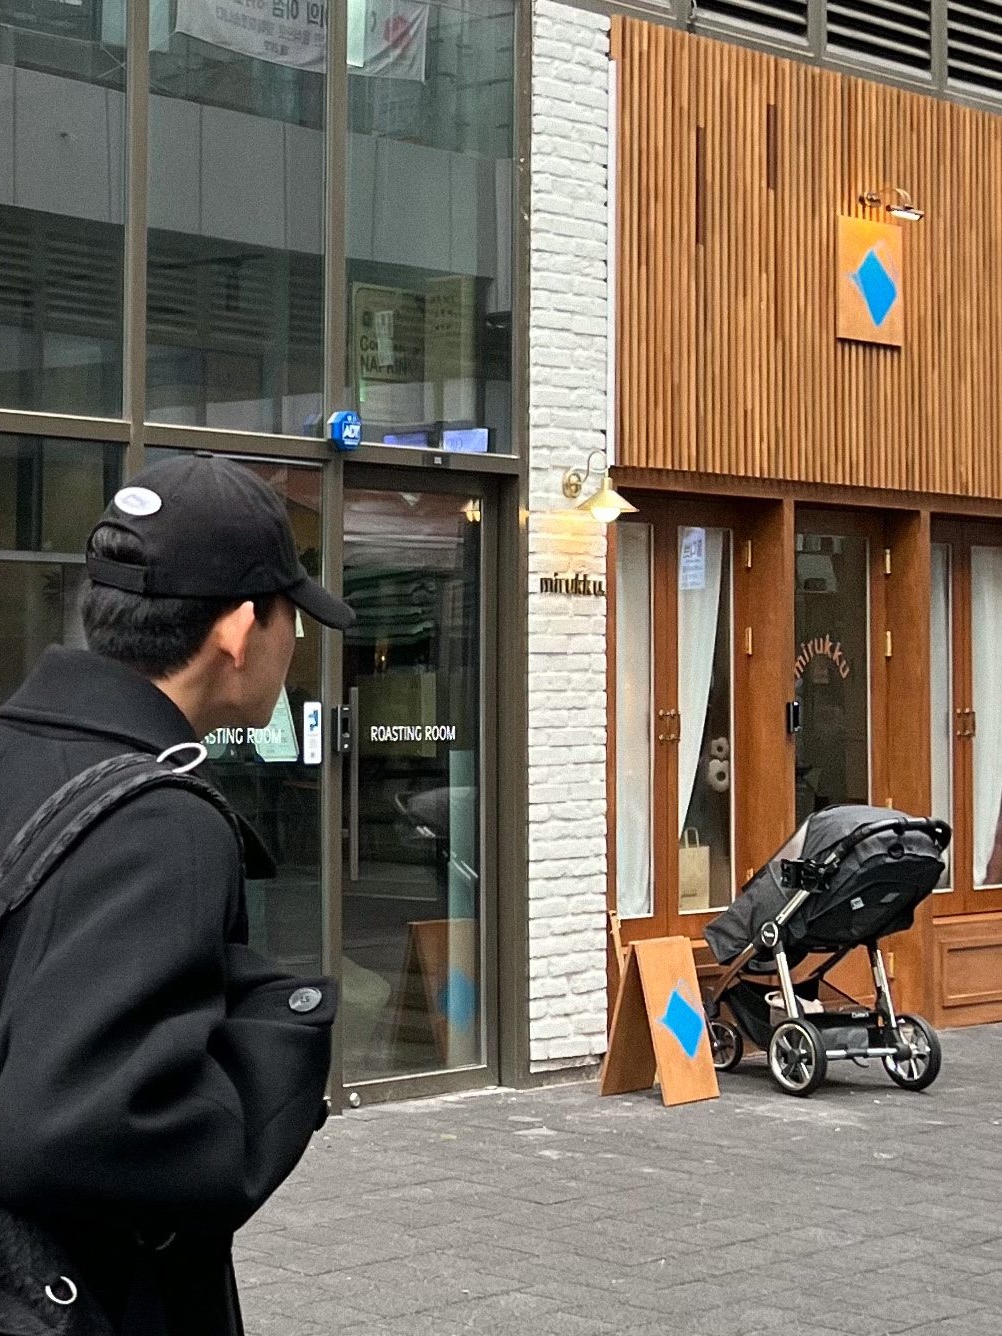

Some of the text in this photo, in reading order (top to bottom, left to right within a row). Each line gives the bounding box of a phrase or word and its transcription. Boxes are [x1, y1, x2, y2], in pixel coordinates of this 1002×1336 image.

[794, 634, 850, 679] mirukku
[203, 727, 282, 745] STING ROOM
[370, 725, 456, 742] ROASTING ROOM
